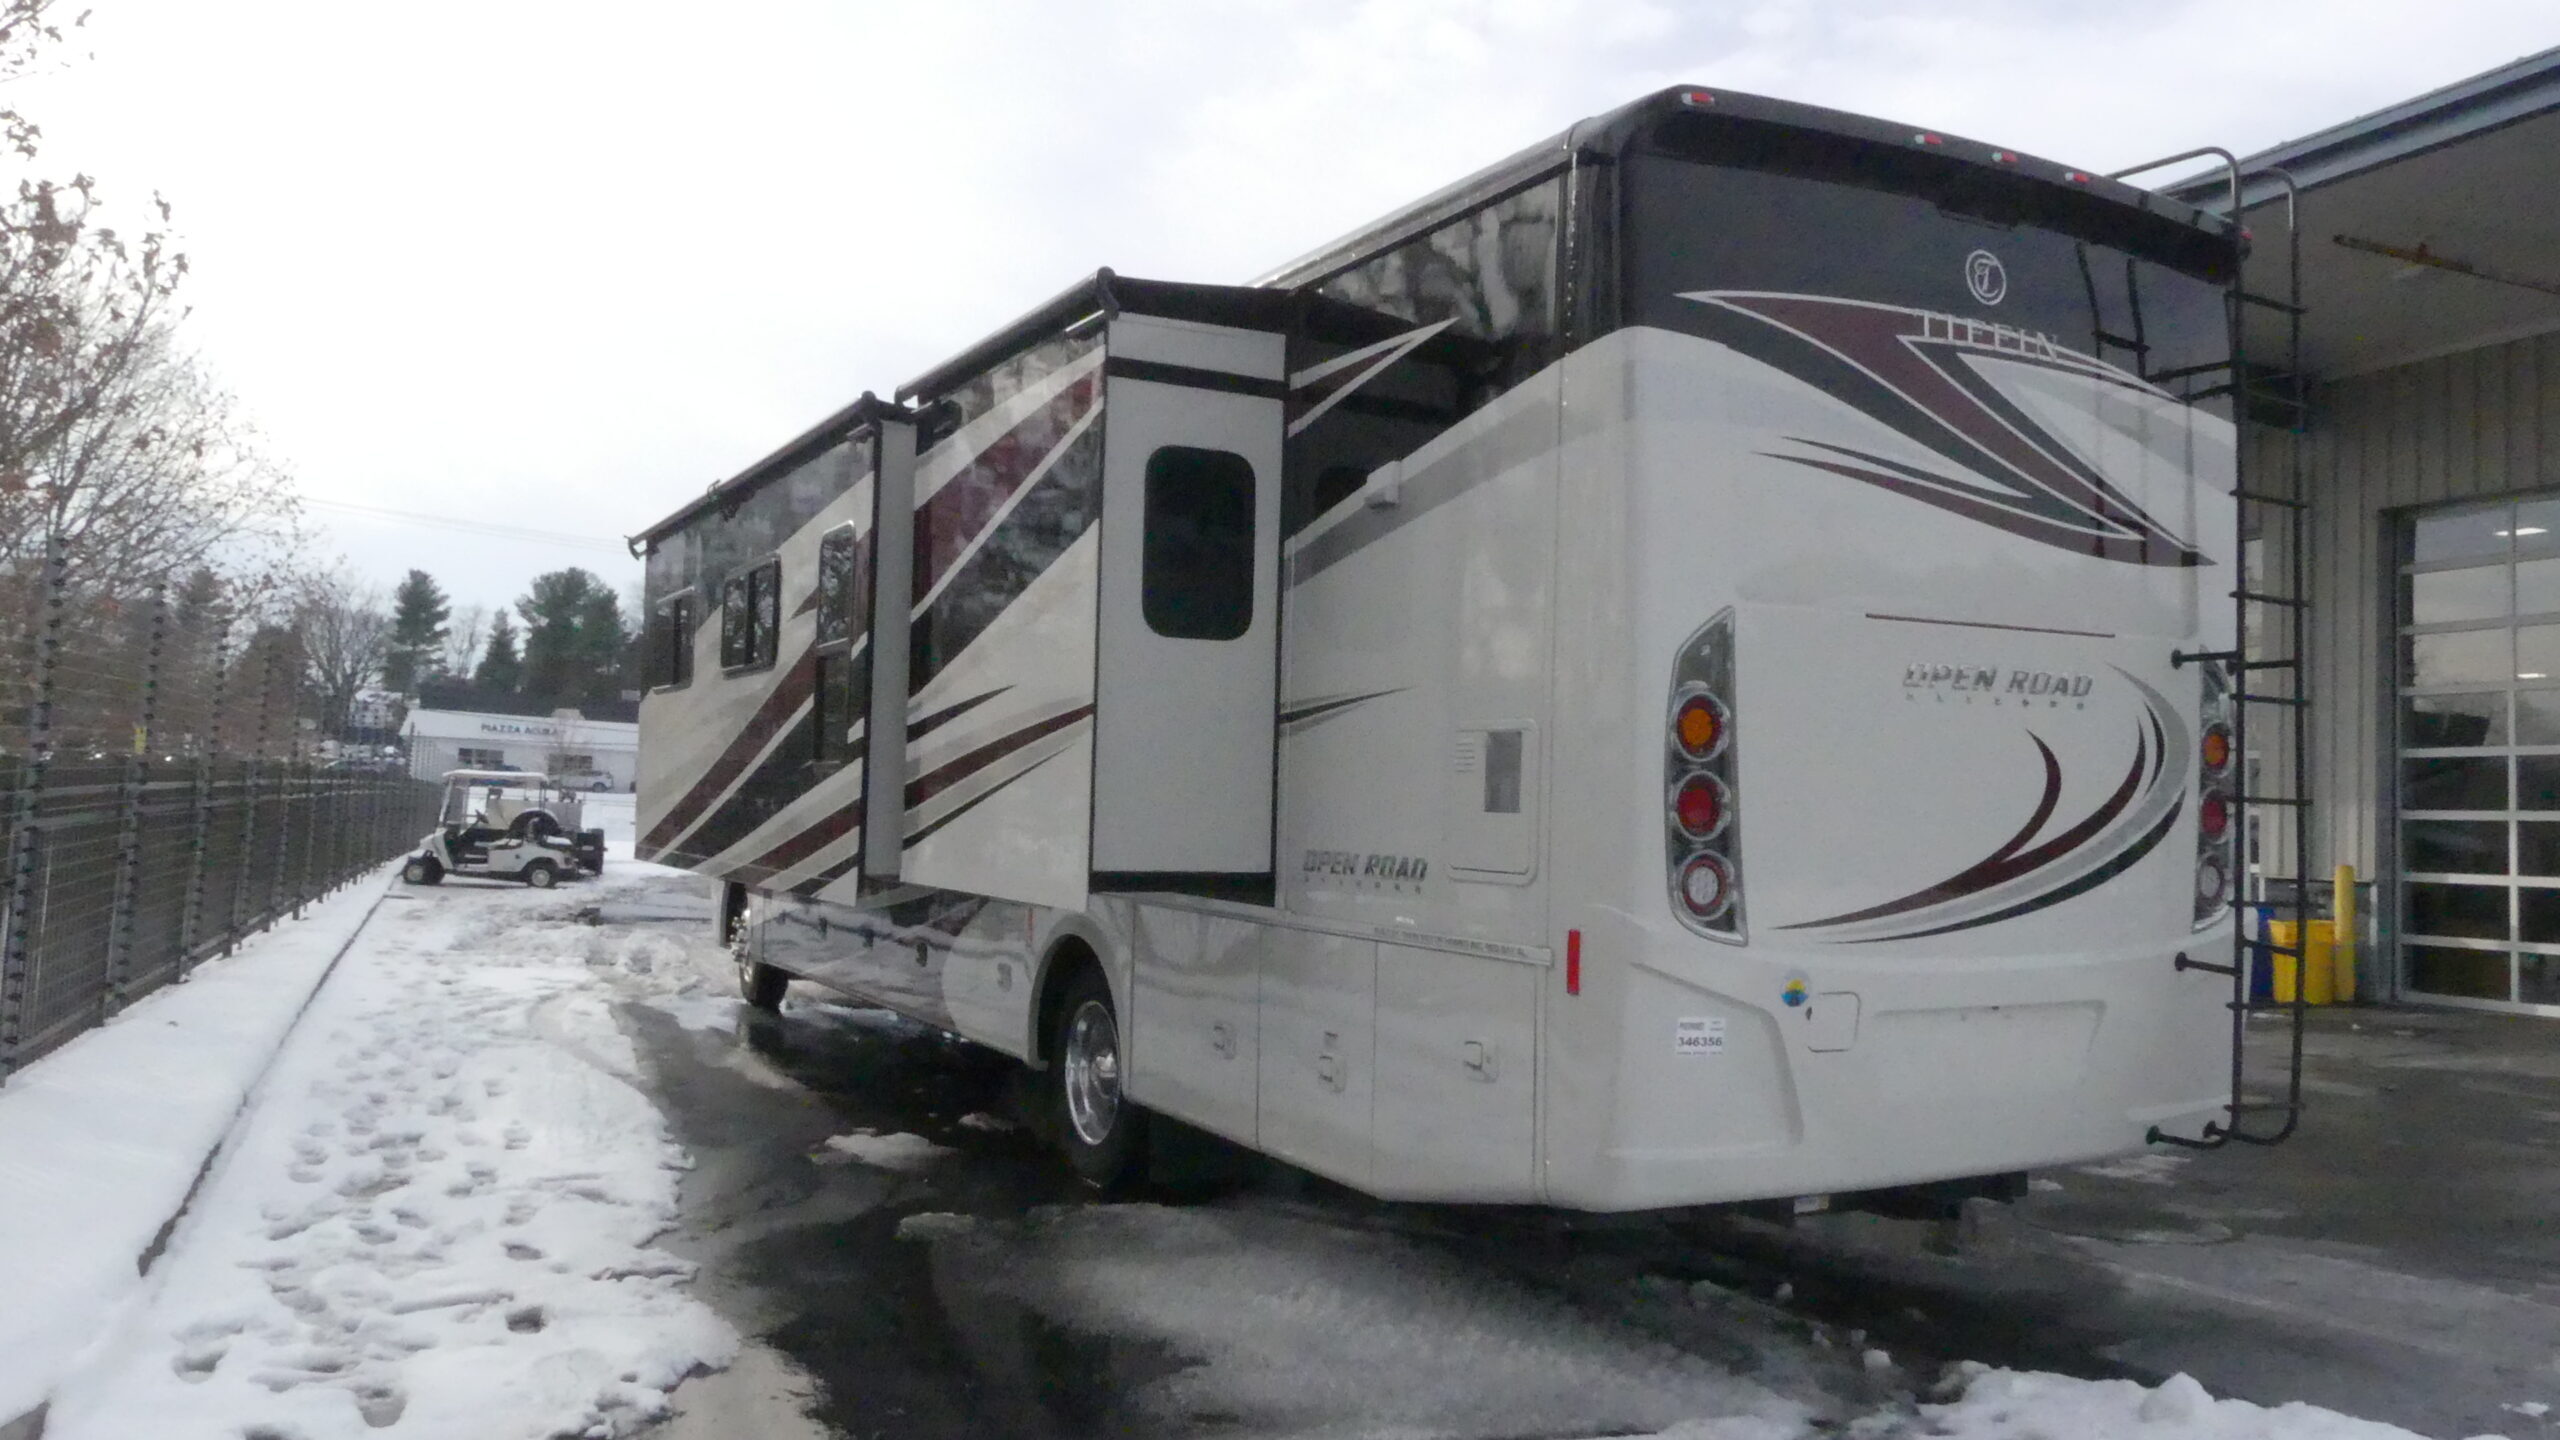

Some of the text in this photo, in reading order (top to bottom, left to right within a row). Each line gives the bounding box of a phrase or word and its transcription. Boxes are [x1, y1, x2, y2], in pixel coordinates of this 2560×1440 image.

[1912, 310, 2058, 361] TIFFIN
[1902, 663, 2093, 697] OPEN ROAD
[1303, 849, 1428, 881] OPEN ROAD
[1678, 1036, 1723, 1047] 346356
